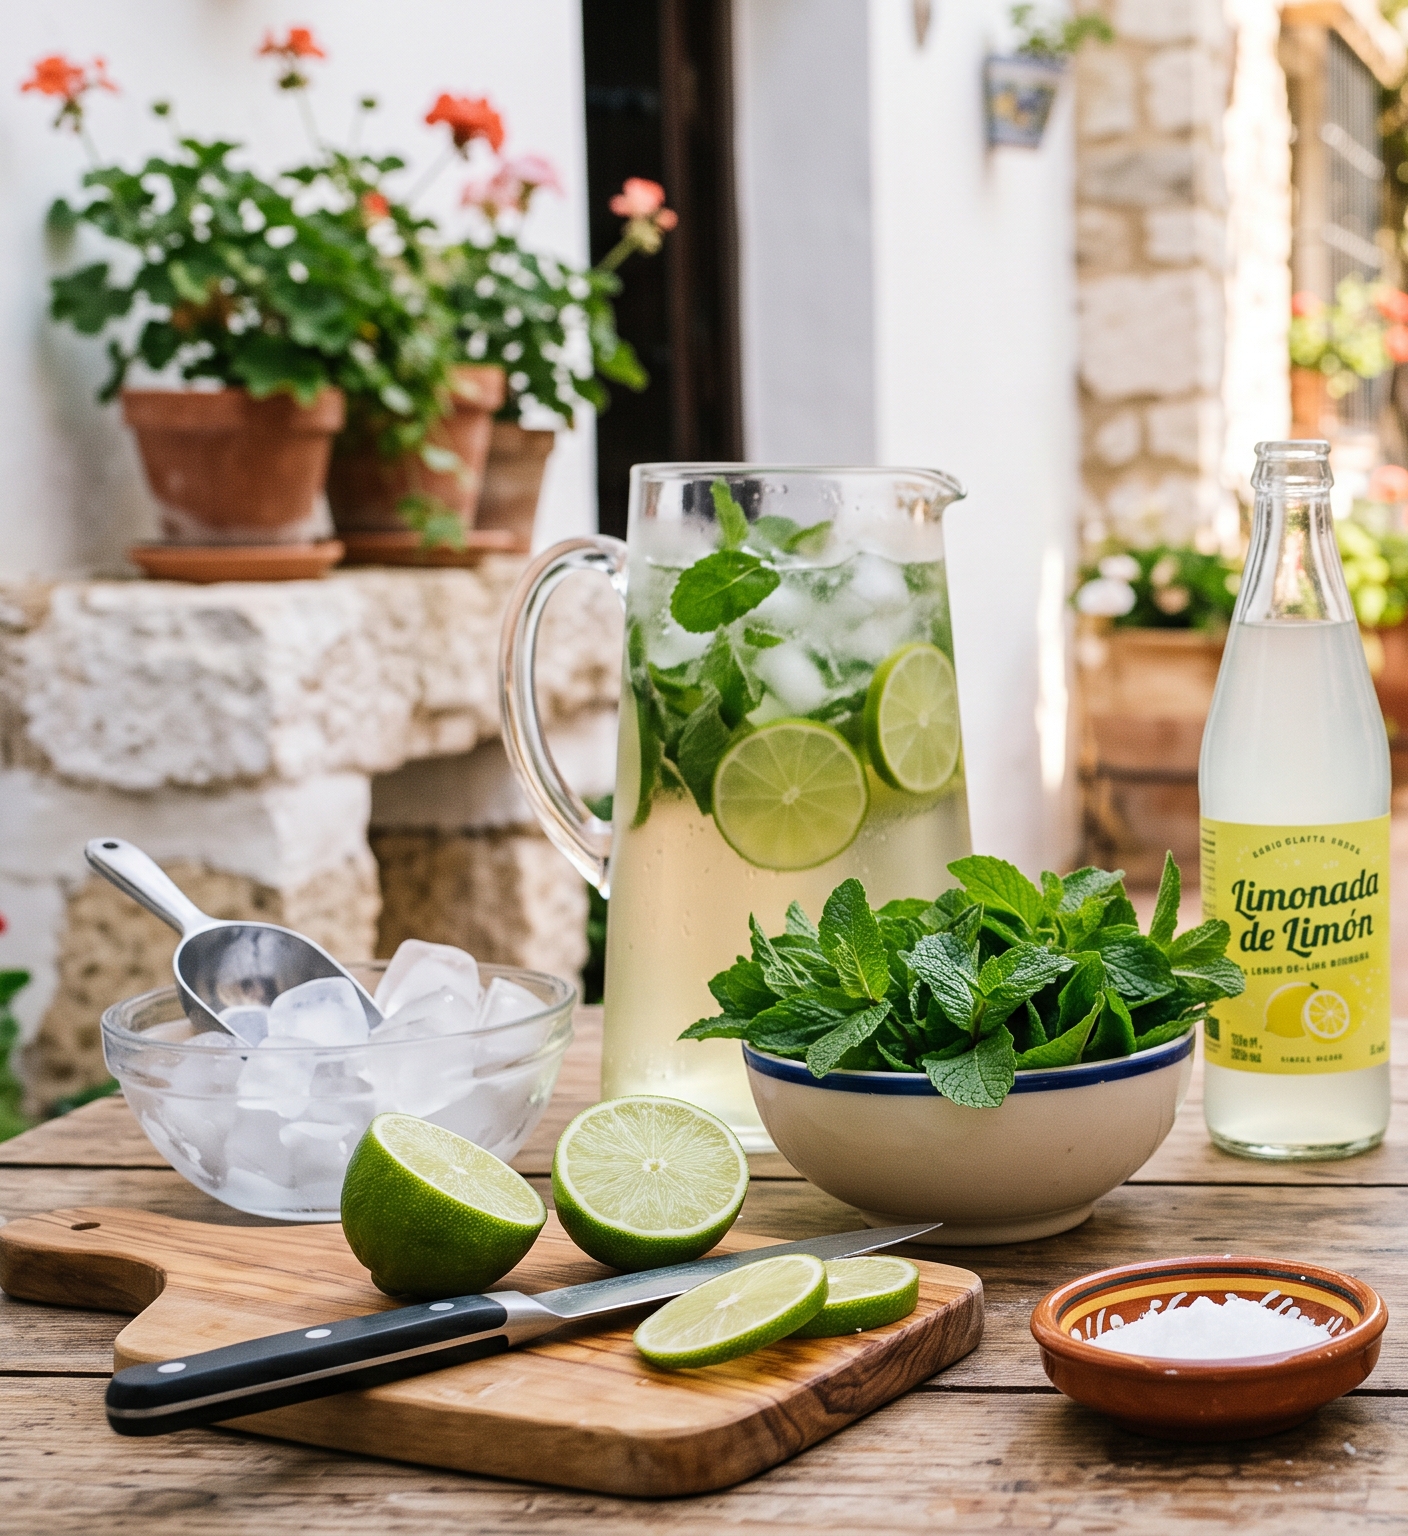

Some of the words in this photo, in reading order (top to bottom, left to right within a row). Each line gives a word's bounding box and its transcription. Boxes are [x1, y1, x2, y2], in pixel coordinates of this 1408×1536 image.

[1231, 869, 1379, 921] Limonada
[1239, 921, 1275, 952] de
[1282, 908, 1374, 958] Limón
